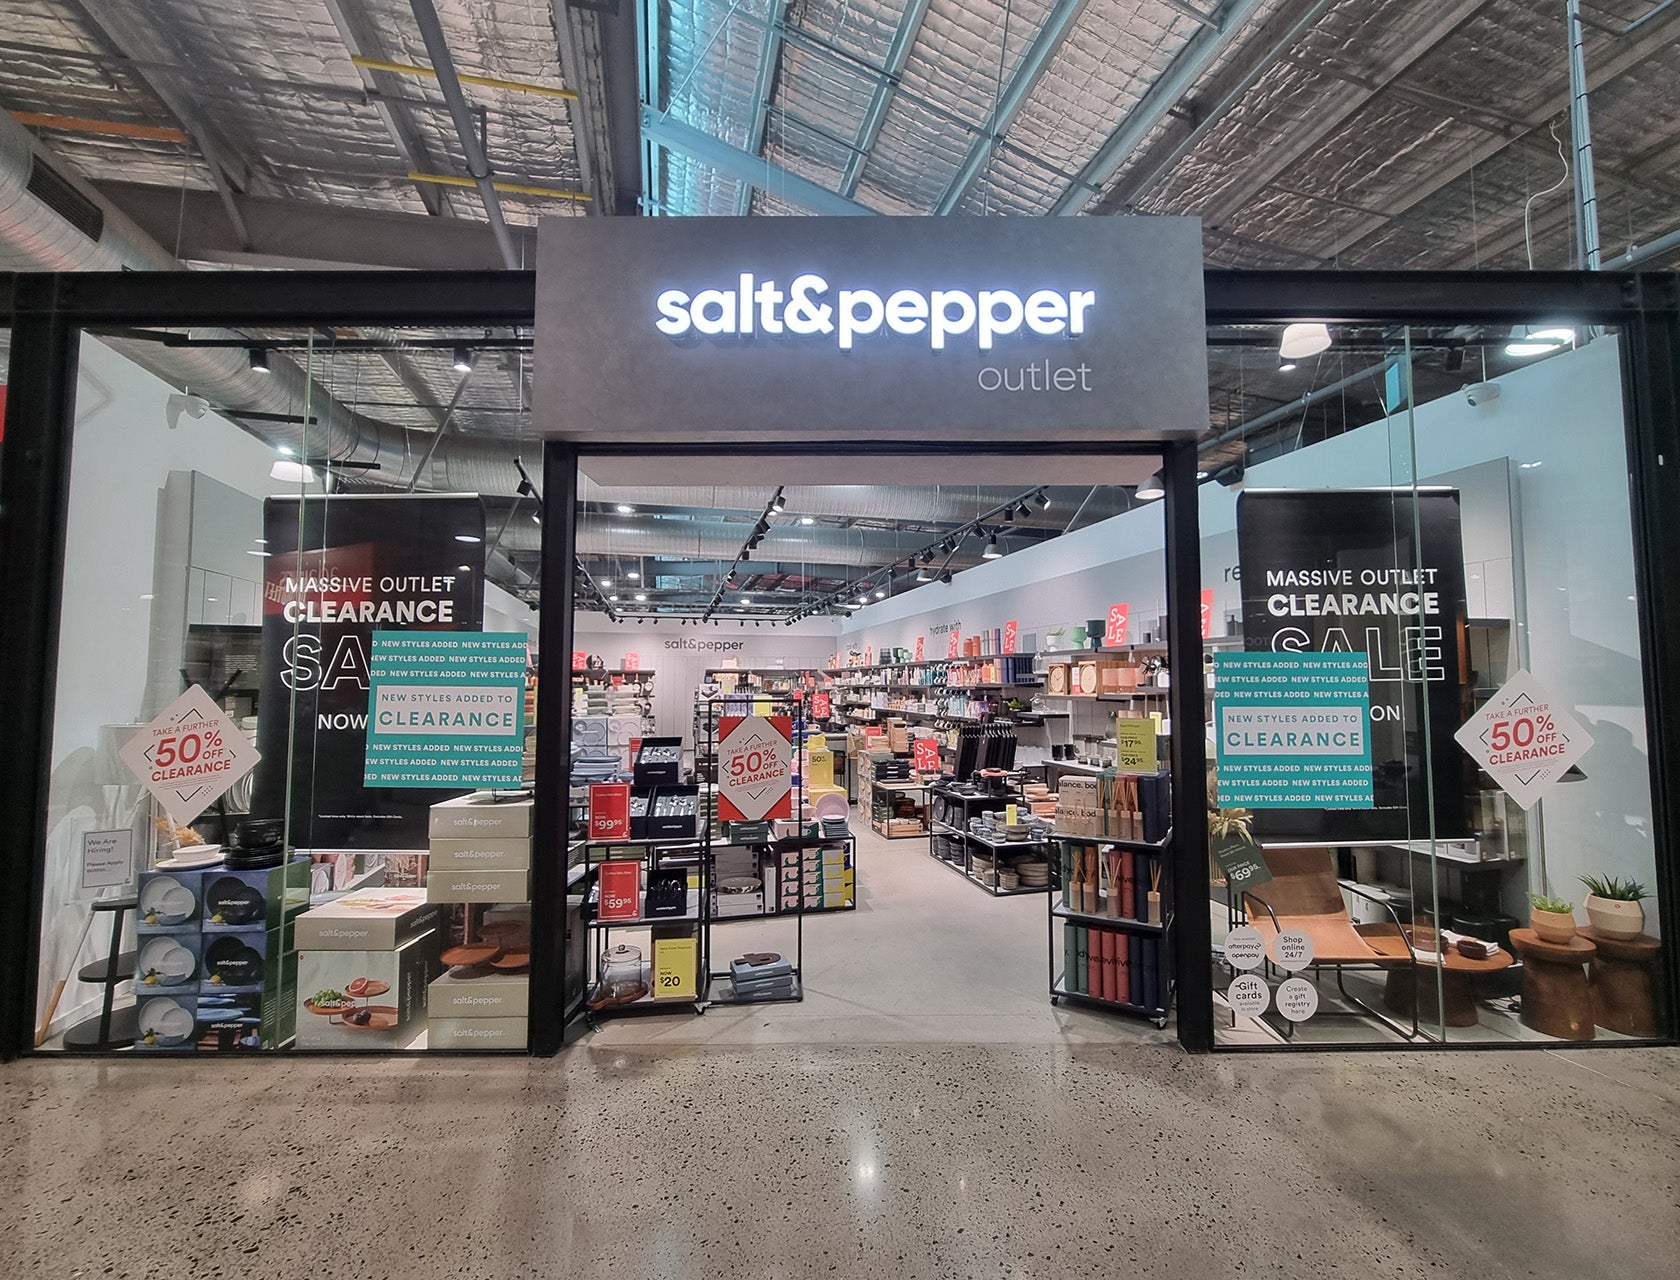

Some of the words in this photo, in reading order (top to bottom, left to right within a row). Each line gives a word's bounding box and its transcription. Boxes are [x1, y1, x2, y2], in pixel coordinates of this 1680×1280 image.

[655, 272, 1096, 350] salt&pepper
[977, 358, 1093, 392] outlet
[285, 576, 372, 593] MASSIVE
[380, 576, 456, 592] OUTLET
[1266, 569, 1353, 586] MASSIVE
[1360, 568, 1438, 586] OUTLET
[284, 600, 453, 624] CLEARANCE
[1267, 593, 1440, 617] CLEARANCE
[664, 638, 744, 652] salt&pepper
[280, 634, 370, 690] SA
[382, 694, 407, 702] NEW
[410, 694, 451, 702] STYLES
[456, 694, 494, 703] ADDED
[498, 695, 512, 703] TO
[1370, 706, 1400, 721] ON
[1514, 704, 1550, 716] FURTHER
[182, 720, 219, 732] FURTHER
[318, 714, 368, 730] NOW
[379, 710, 513, 727] CLEARANCE
[1228, 714, 1252, 723] NEW
[1256, 714, 1298, 723] STYLES
[1302, 714, 1338, 723] ADDED
[1343, 714, 1358, 723] TO
[1227, 732, 1360, 747] CLEARANCE
[1490, 714, 1554, 751] 50%
[1536, 732, 1557, 744] OFF
[154, 730, 222, 768] 50%
[202, 748, 224, 760] OFF
[1489, 743, 1565, 766] CLEARANCE
[730, 748, 776, 776] 50%
[763, 760, 778, 770] OFF
[151, 759, 231, 782] CLEARANCE
[729, 768, 784, 787] CLEARANCE
[660, 976, 680, 986] $20
[1239, 982, 1258, 990] Gift
[1236, 991, 1262, 1000] cards
